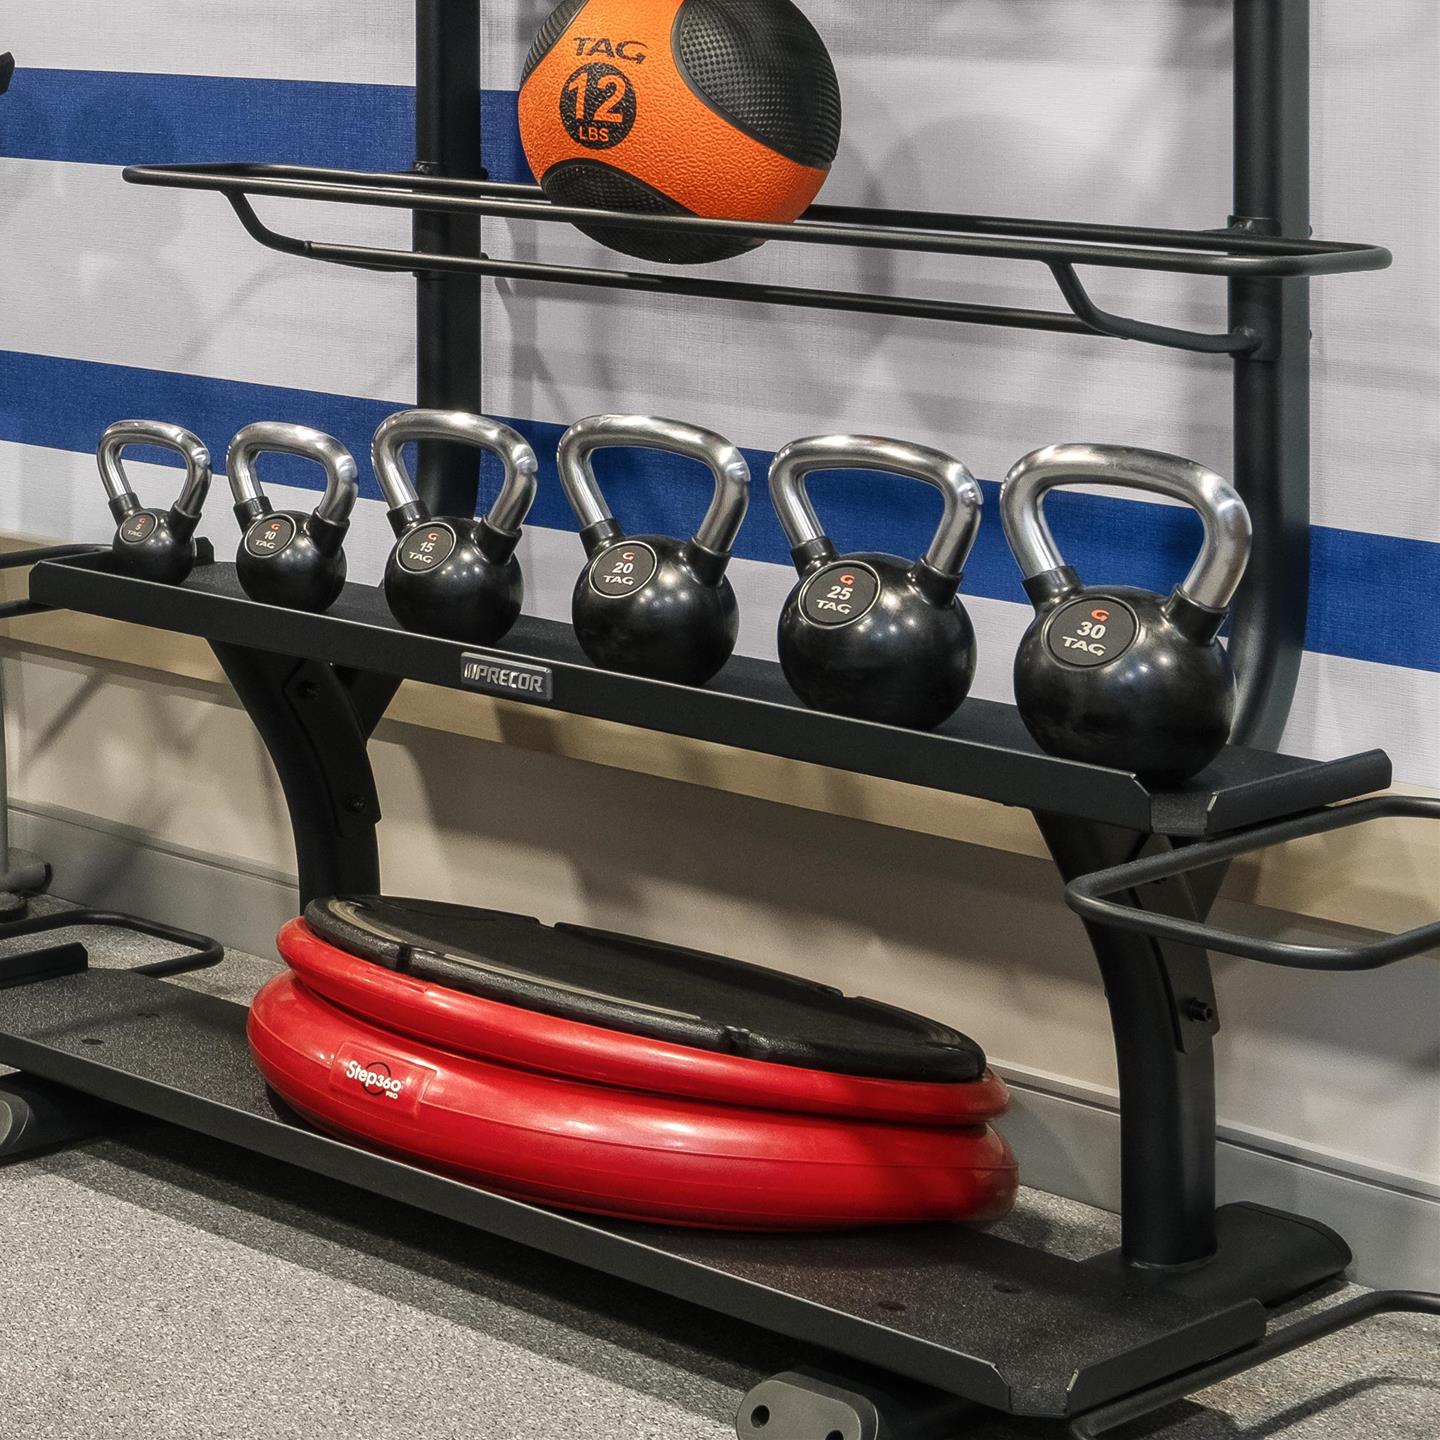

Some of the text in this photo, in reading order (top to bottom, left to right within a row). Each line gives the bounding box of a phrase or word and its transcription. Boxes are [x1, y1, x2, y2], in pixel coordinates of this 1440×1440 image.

[574, 37, 648, 64] TAG
[568, 72, 626, 123] 12
[579, 126, 609, 141] LBS
[264, 531, 276, 541] 10
[255, 539, 276, 549] TAG
[420, 542, 434, 553] 15
[408, 551, 433, 564] TAG
[612, 562, 634, 575] 20
[603, 574, 635, 586] TAG
[827, 585, 853, 600] 25
[816, 599, 852, 615] TAG
[1077, 621, 1106, 640] 30
[1061, 636, 1107, 657] TAG
[475, 664, 544, 693] PRECOR
[346, 1060, 402, 1092] Step360
